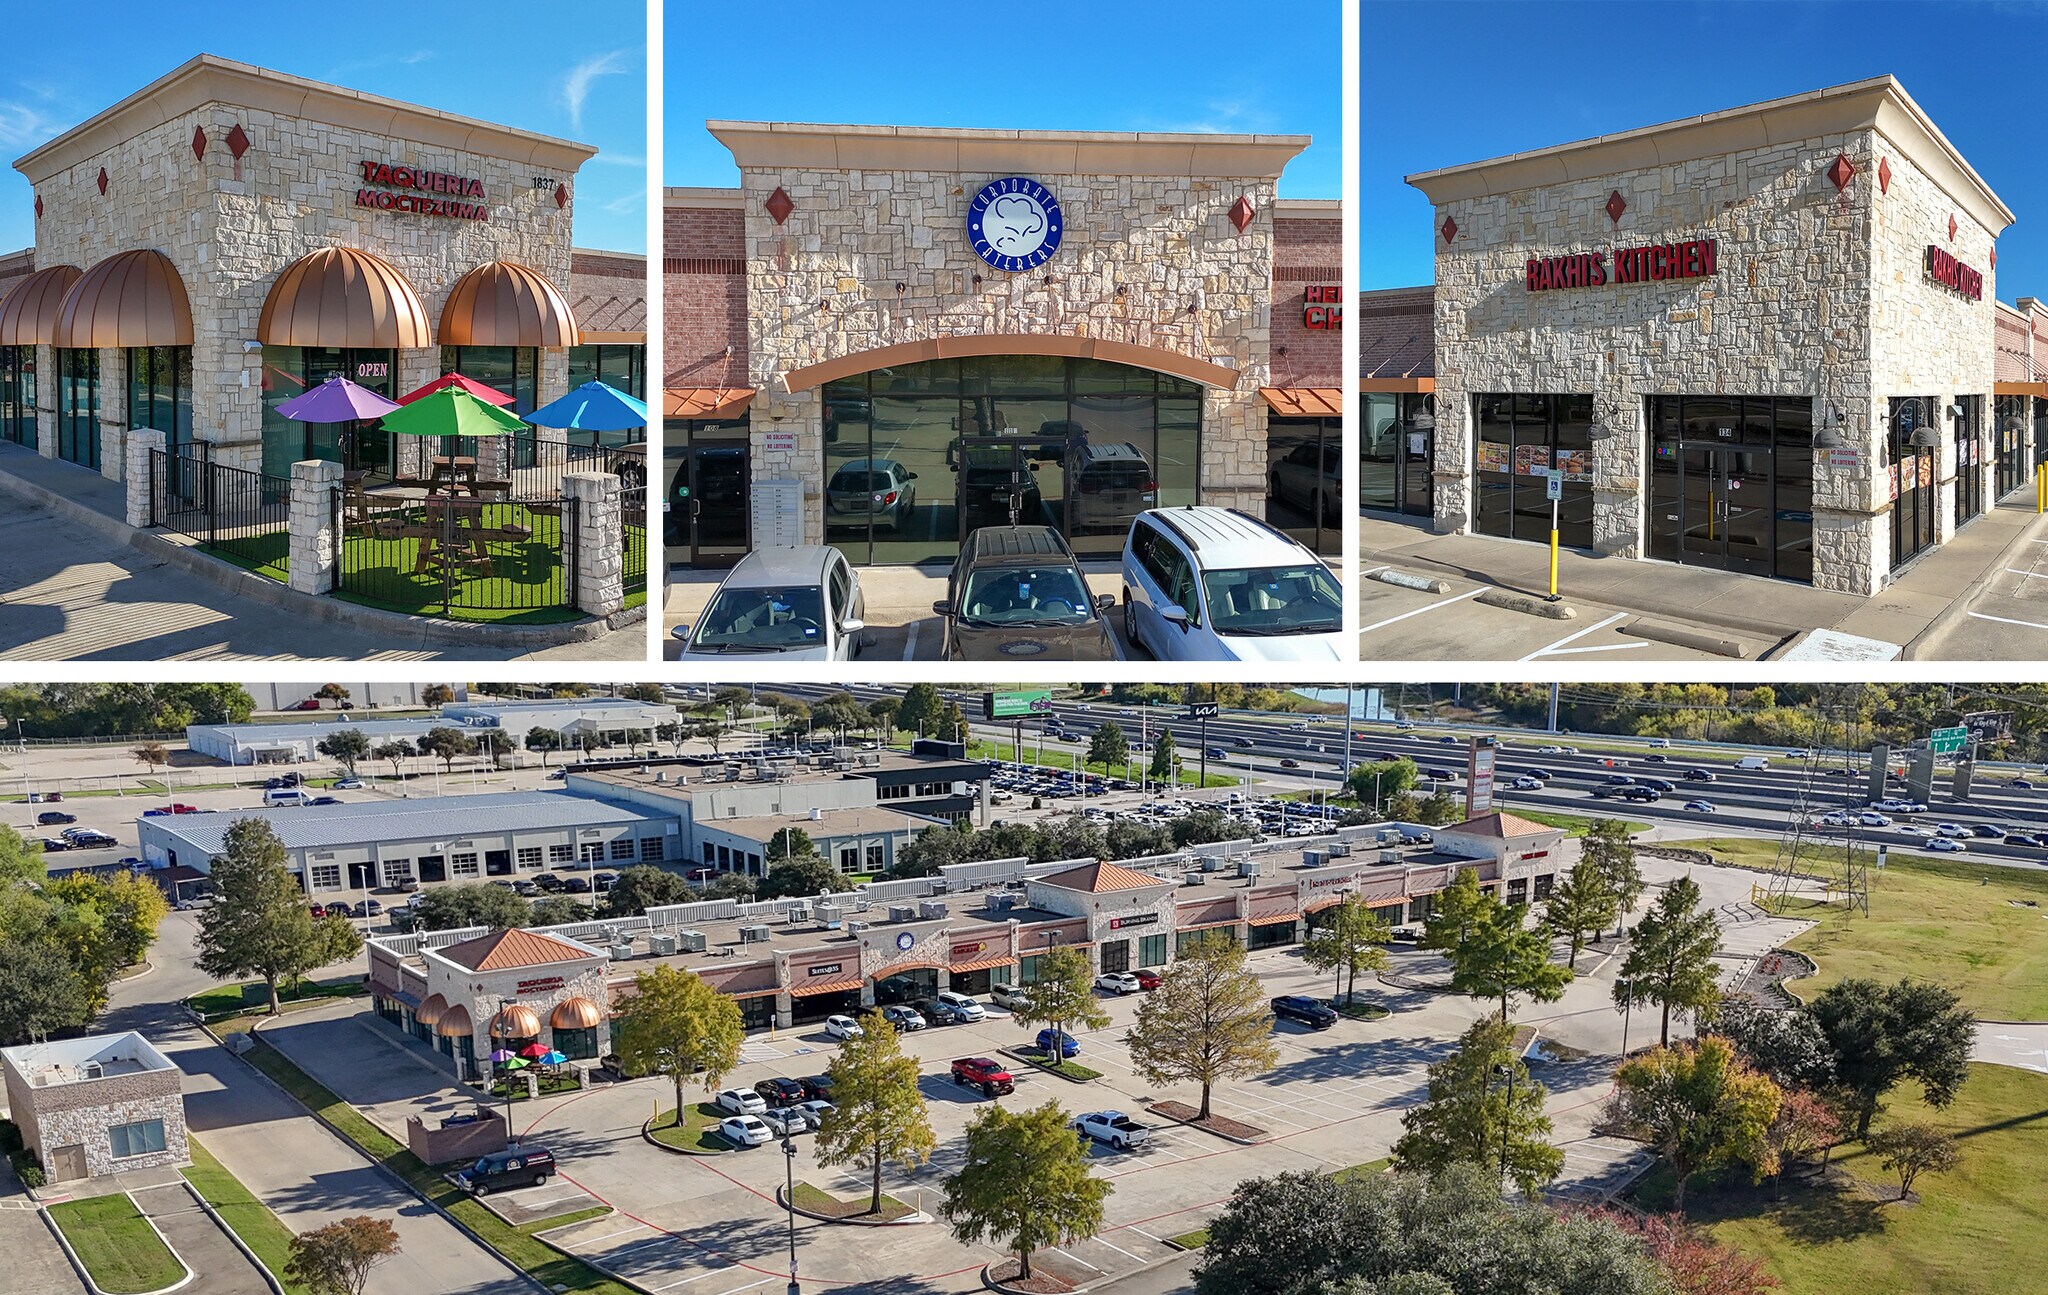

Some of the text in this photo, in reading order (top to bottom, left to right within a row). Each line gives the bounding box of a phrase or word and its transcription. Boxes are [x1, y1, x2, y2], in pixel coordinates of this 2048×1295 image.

[360, 161, 486, 199] TAQUERIA
[532, 176, 554, 190] 1837
[356, 188, 489, 221] MOCTEZUMA
[972, 178, 1058, 214] CORPORATE
[974, 239, 1055, 270] CATERERS
[1526, 239, 1717, 291] RAKHIS KITCHEN
[1931, 245, 1982, 301] RAKHIS KITCHEN
[1305, 286, 1342, 303] HE
[358, 363, 388, 377] OPEN
[1195, 706, 1217, 716] KIA
[516, 984, 566, 995] MOCTEZUMA
[517, 976, 564, 988] TAQUERIA
